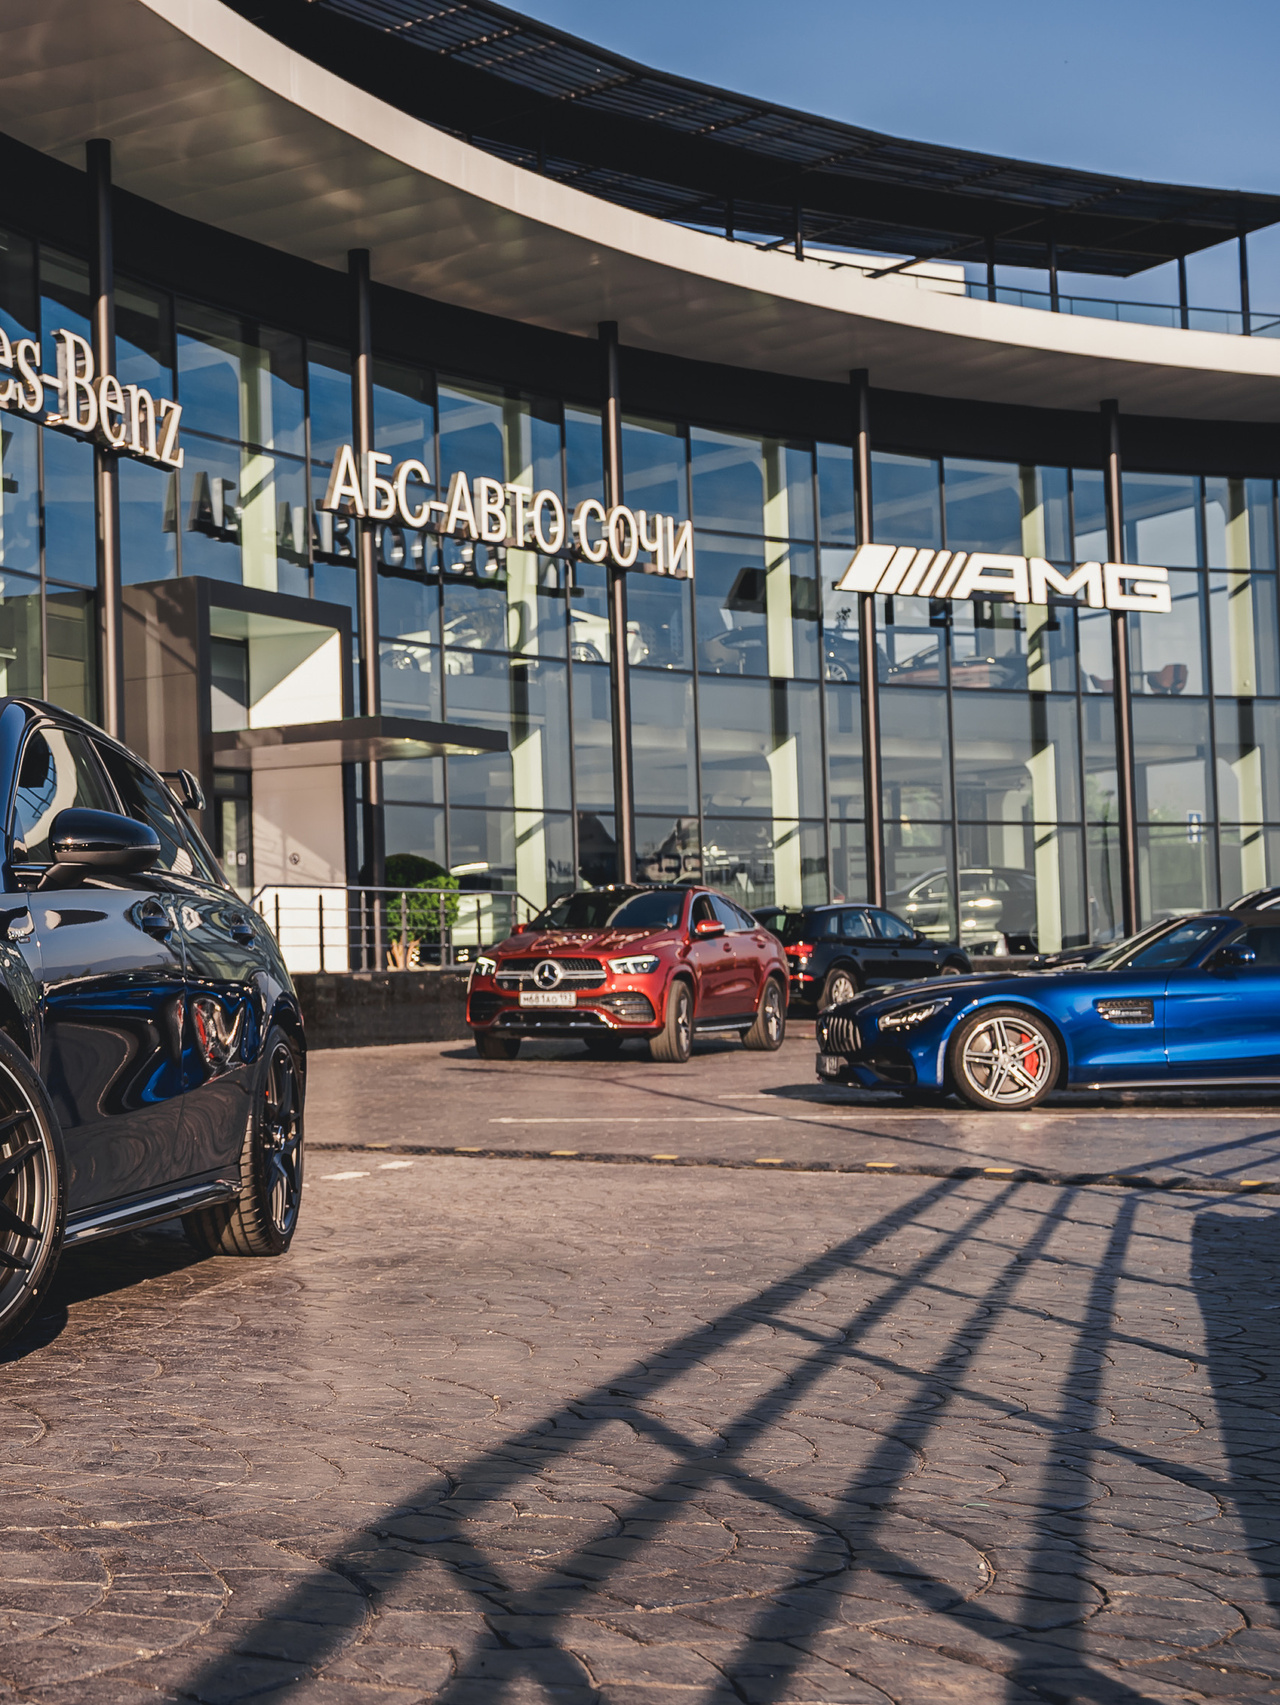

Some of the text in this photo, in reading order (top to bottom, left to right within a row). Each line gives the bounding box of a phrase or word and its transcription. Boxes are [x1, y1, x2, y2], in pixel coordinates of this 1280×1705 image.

[322, 443, 567, 555] АБС-АВТО
[574, 498, 695, 579] СОЧИ
[950, 551, 1172, 614] AMG
